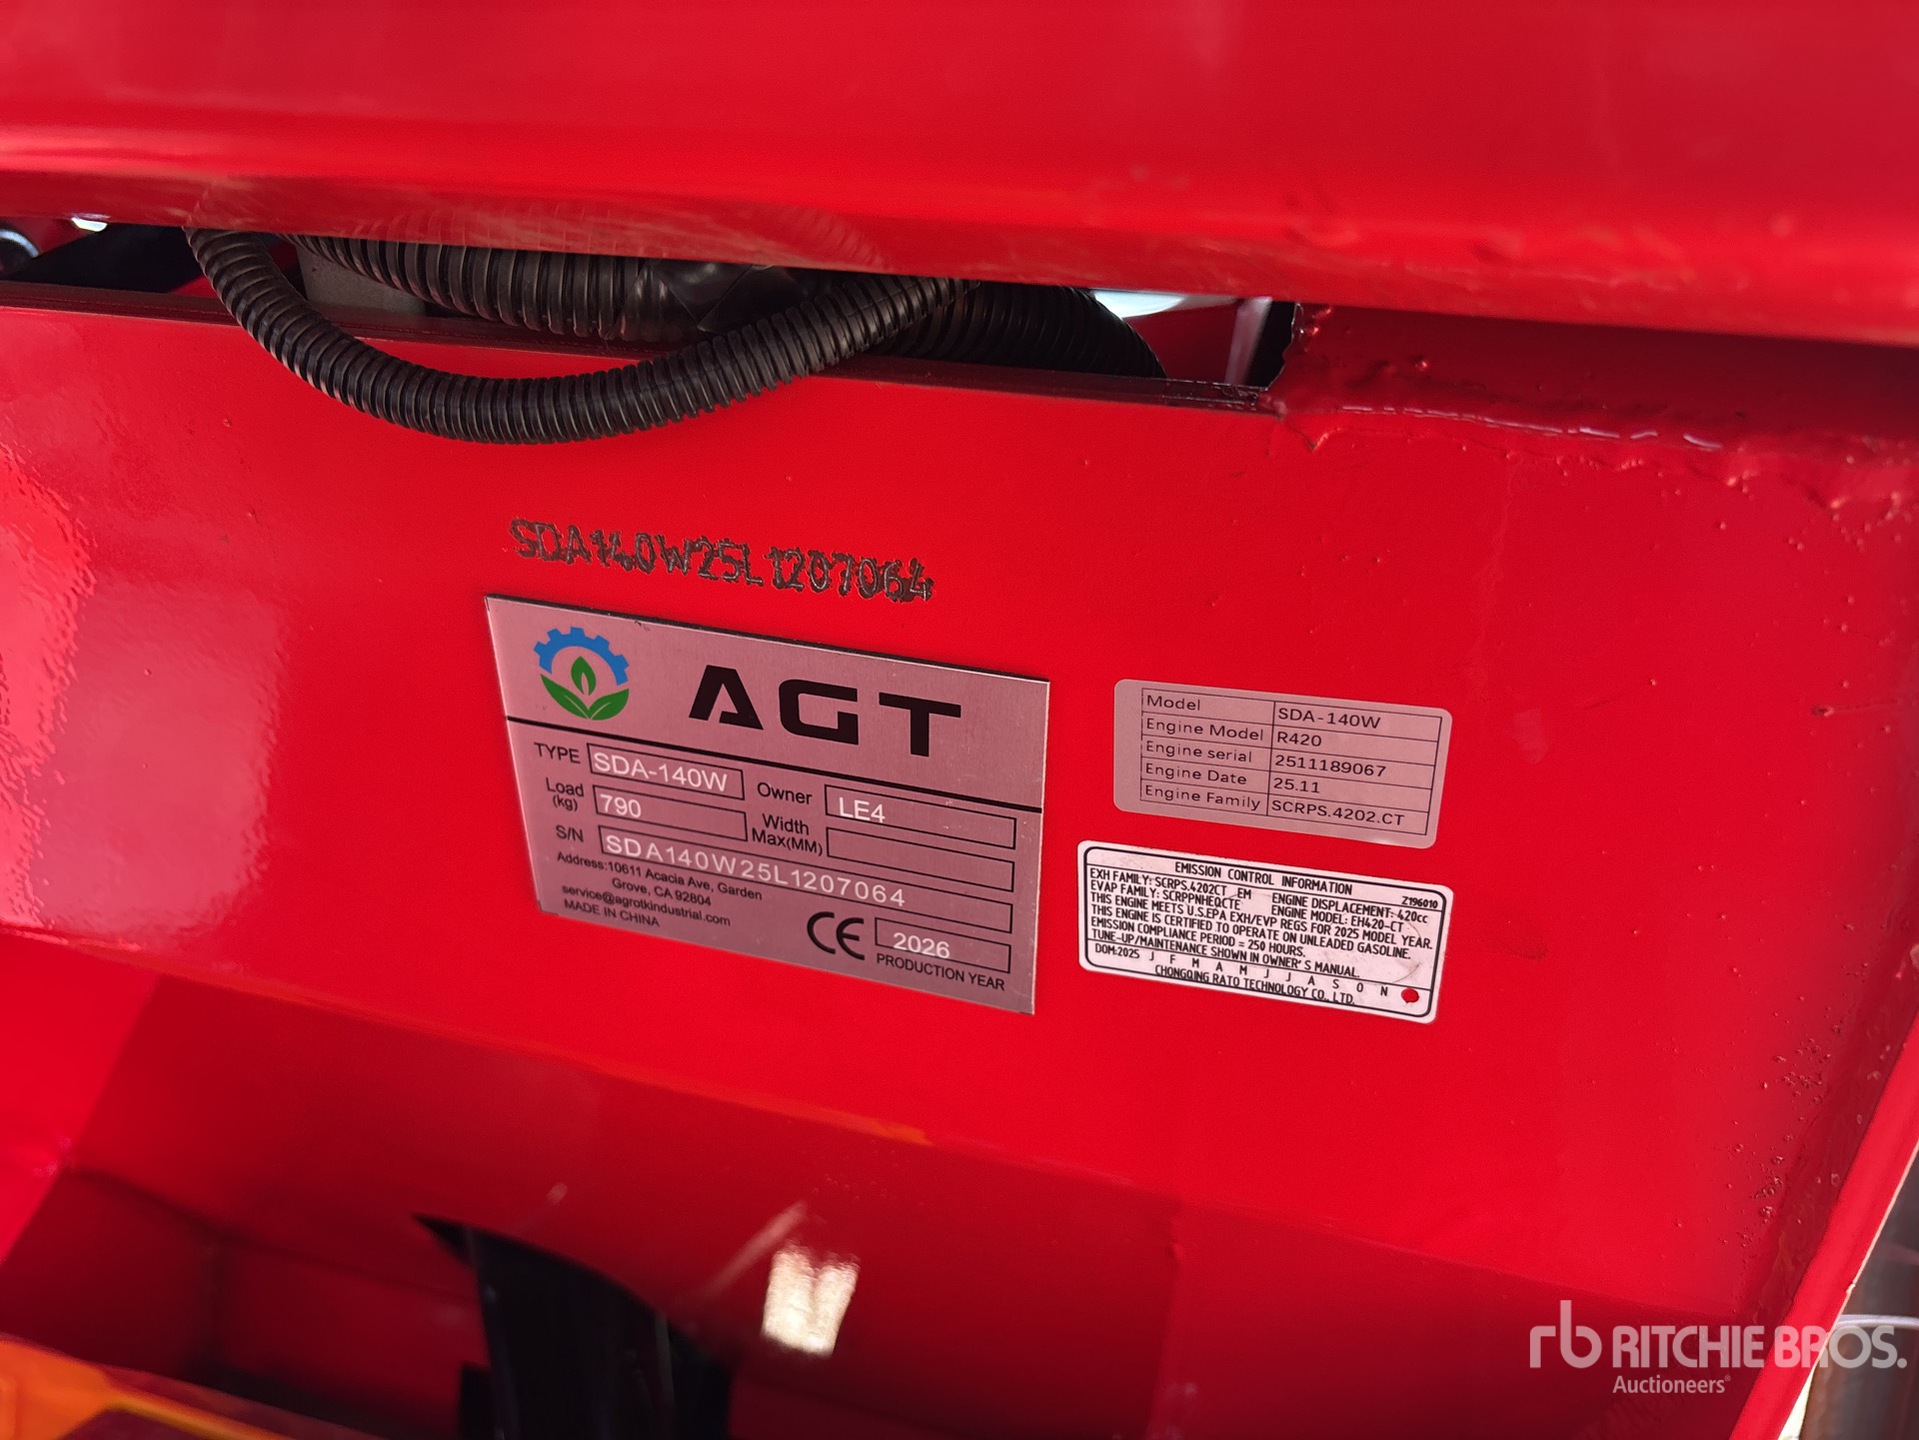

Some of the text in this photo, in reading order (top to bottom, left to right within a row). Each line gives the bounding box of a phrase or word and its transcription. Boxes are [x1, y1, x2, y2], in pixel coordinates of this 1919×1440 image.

[688, 664, 961, 757] AGT
[1146, 695, 1381, 729] Model SDA-140W
[1146, 718, 1322, 747] Engine Model R420
[534, 742, 728, 792] TYPE SDA-140W
[1146, 741, 1387, 777] Engine serial 2511189067
[545, 777, 584, 797] Load
[1145, 763, 1320, 794] Engine Date 25.11
[552, 793, 642, 818] (kg) 790
[757, 782, 886, 823] Owner LE4
[1145, 784, 1405, 826] Engine Family SCRPS.4202.CT
[762, 813, 809, 835] Width
[752, 828, 823, 857] Max(MM)
[555, 825, 905, 906] S/N SDA140W25L1207064
[1175, 862, 1352, 895] EMISSION CONTROL INFORMATION
[612, 877, 712, 907] Grove, CA 92804
[645, 868, 684, 886] Acacia
[688, 876, 714, 892] Ave,
[717, 882, 763, 901] Garden
[1090, 868, 1251, 899] EXH FAMILY: SCRPS.4202CT EM
[1090, 880, 1118, 893] EVAP
[1120, 884, 1160, 899] FAMILY:
[564, 898, 660, 927] MADE IN CHINA
[1271, 905, 1404, 932] ENGINE MODEL: EH420-CT
[1272, 892, 1428, 923] ENGINE DISPLACEMENT: 420cc
[1402, 896, 1438, 909] Z196010
[1091, 892, 1112, 904] THIS
[1115, 895, 1148, 910] ENGINE
[1151, 900, 1184, 914] MEETS
[1230, 911, 1277, 927] EXH/EVP
[1281, 919, 1307, 932] REGS
[1311, 924, 1331, 936] FOR
[1334, 927, 1359, 939] 2025
[1362, 930, 1397, 945] MODEL
[1401, 935, 1433, 950] YEAR.
[1091, 916, 1135, 932] EMISSION
[1137, 923, 1197, 942] COMPLIANCE
[1200, 933, 1235, 947] PERIOD
[1248, 939, 1265, 951] 250
[1269, 942, 1306, 957] HOURS.
[1092, 904, 1411, 960] THIS ENGINE IS CERTIFIED TO OPERATE ON UNLEADED GASOLINE.
[893, 932, 950, 959] 2026
[1092, 928, 1208, 955] TUNE-UP/MAINTENANCE
[1210, 946, 1247, 961] SHOWN
[1250, 952, 1260, 962] IN
[1314, 962, 1360, 978] MANUAL.
[876, 953, 1005, 991] PRODUCTION YEAR
[1095, 943, 1140, 959] DOM:2025
[1170, 954, 1176, 964] F
[1192, 958, 1200, 968] M
[1216, 961, 1223, 972] A
[1240, 965, 1247, 975] M
[1307, 975, 1316, 986] A
[1333, 979, 1340, 989] S
[1380, 986, 1388, 996] N
[1155, 965, 1210, 983] CHONGQING
[1213, 973, 1240, 987] RATO
[1244, 978, 1308, 997] TECHNOLOGY
[1333, 992, 1355, 1004] LTD.
